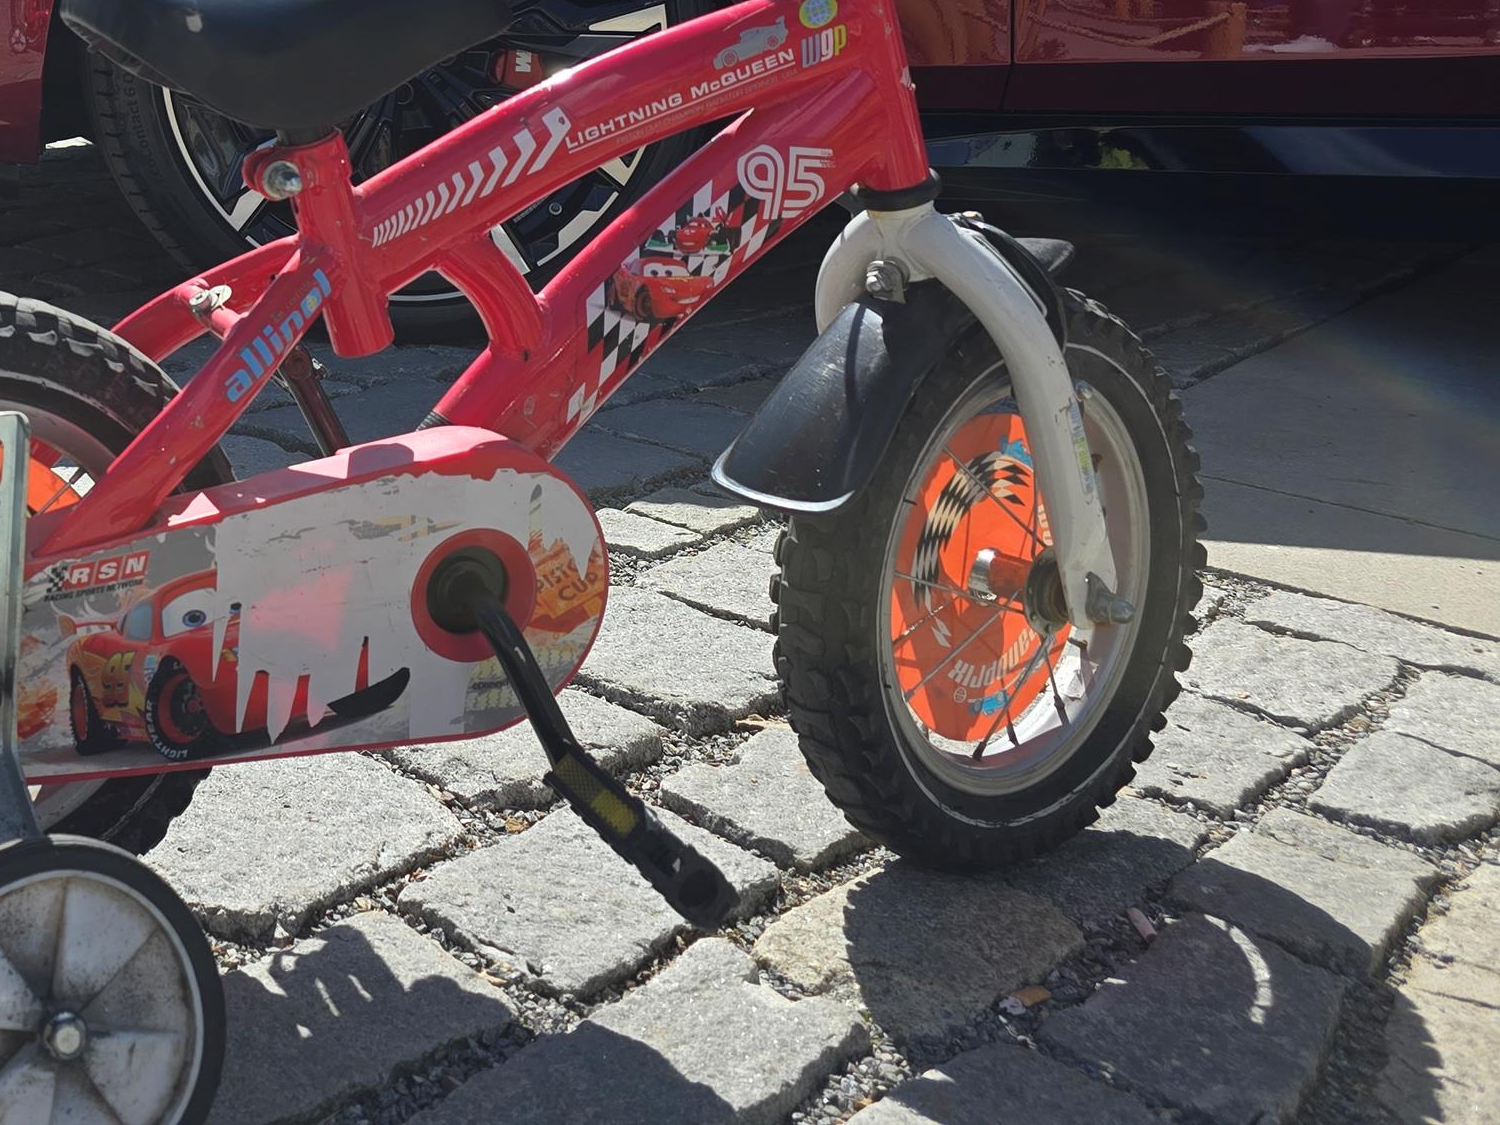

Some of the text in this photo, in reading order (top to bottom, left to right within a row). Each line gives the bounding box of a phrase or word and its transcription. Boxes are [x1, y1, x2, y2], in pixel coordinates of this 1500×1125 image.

[801, 24, 847, 68] wgp
[565, 48, 795, 150] LIGHTNING McQUEEN
[737, 144, 833, 219] 95
[224, 268, 332, 402] allinol
[44, 578, 144, 602] RACING SPORTS NETWORK
[71, 555, 146, 584] RSN
[558, 572, 598, 601] CUP
[146, 700, 188, 758] LIGHTYEAR
